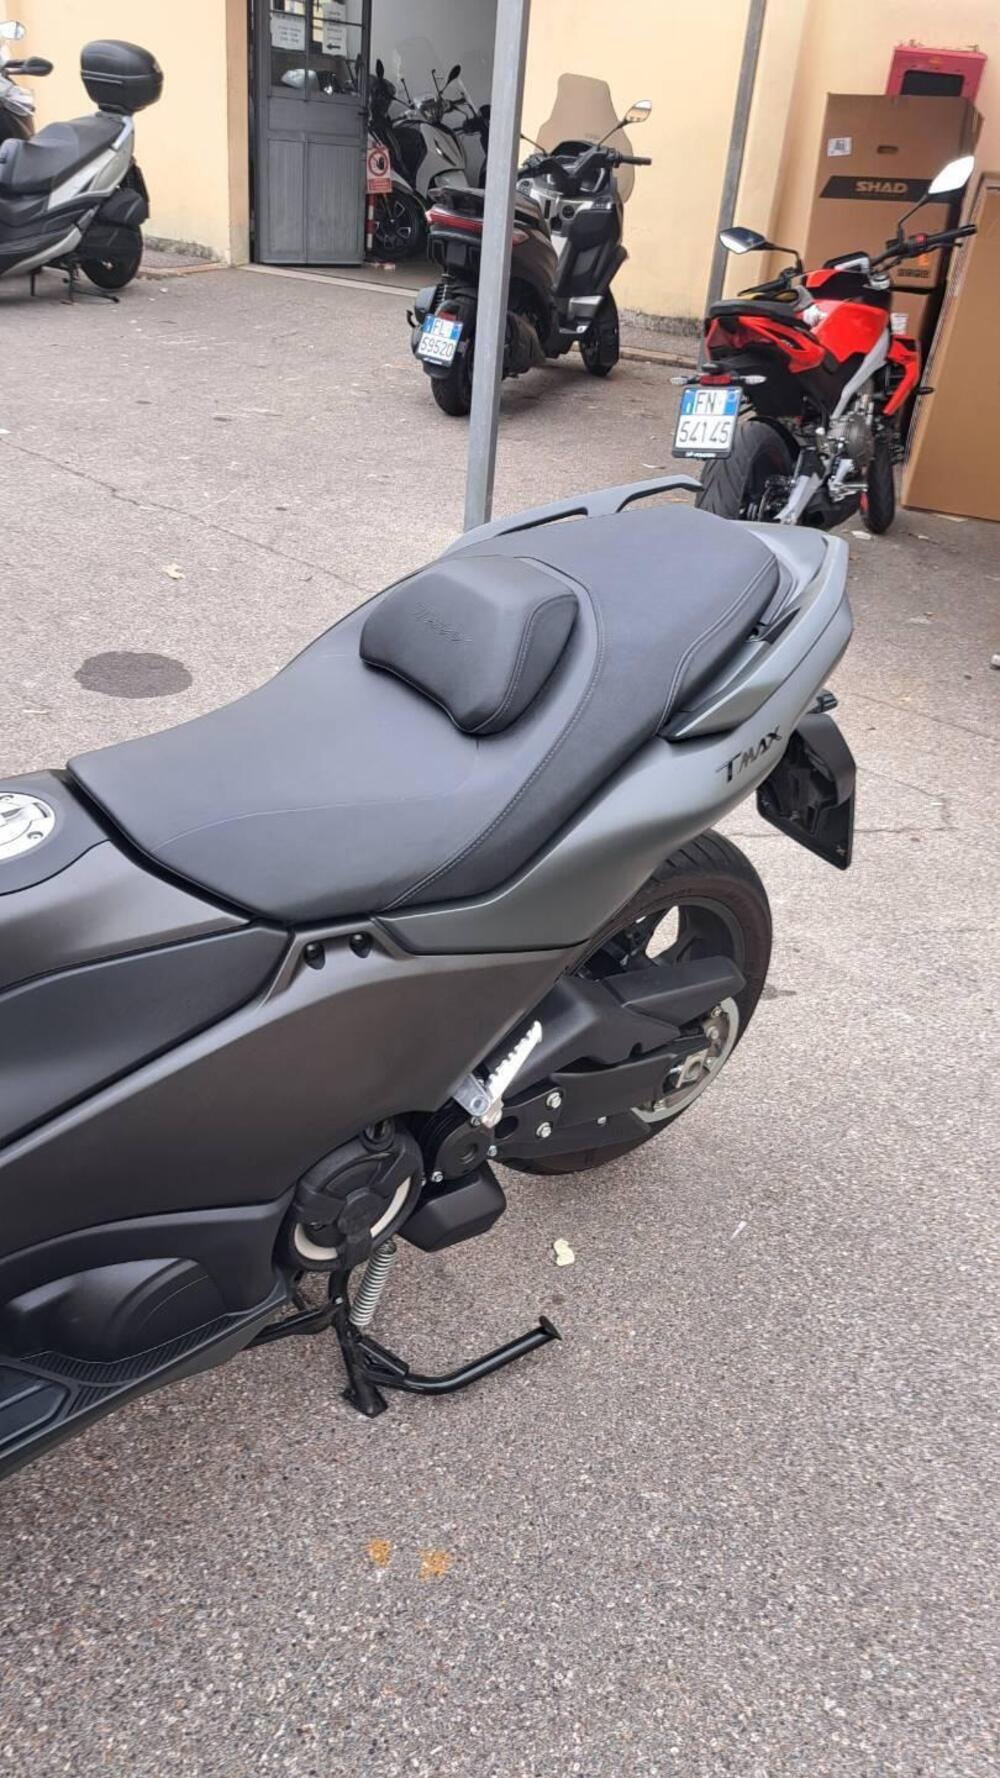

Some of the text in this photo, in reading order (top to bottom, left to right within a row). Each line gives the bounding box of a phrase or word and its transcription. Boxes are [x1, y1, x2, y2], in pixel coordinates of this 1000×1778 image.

[855, 181, 909, 194] SHAD
[432, 319, 447, 336] FL
[420, 336, 454, 358] 59520
[695, 392, 717, 413] FN
[679, 421, 730, 443] 54145
[715, 724, 782, 783] TMAX
